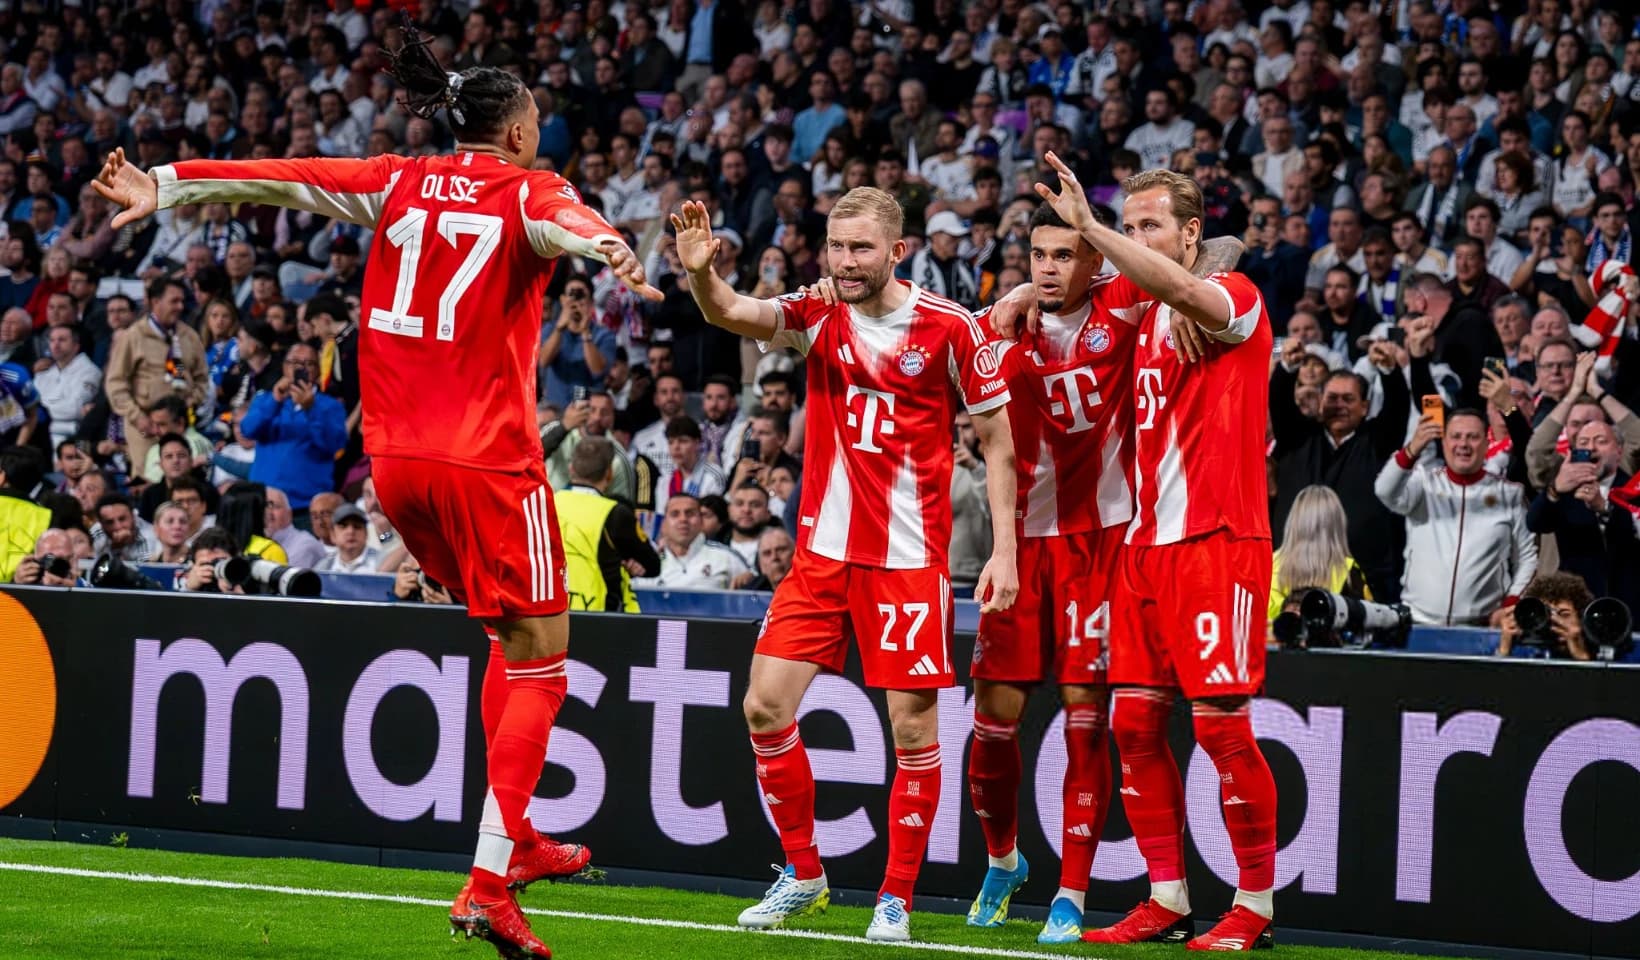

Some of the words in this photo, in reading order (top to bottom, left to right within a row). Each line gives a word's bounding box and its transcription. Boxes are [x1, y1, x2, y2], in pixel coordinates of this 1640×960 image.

[368, 207, 505, 342] 17
[846, 384, 896, 454] T
[877, 602, 930, 652] 27
[1065, 600, 1111, 647] 14
[1196, 611, 1220, 660] 9
